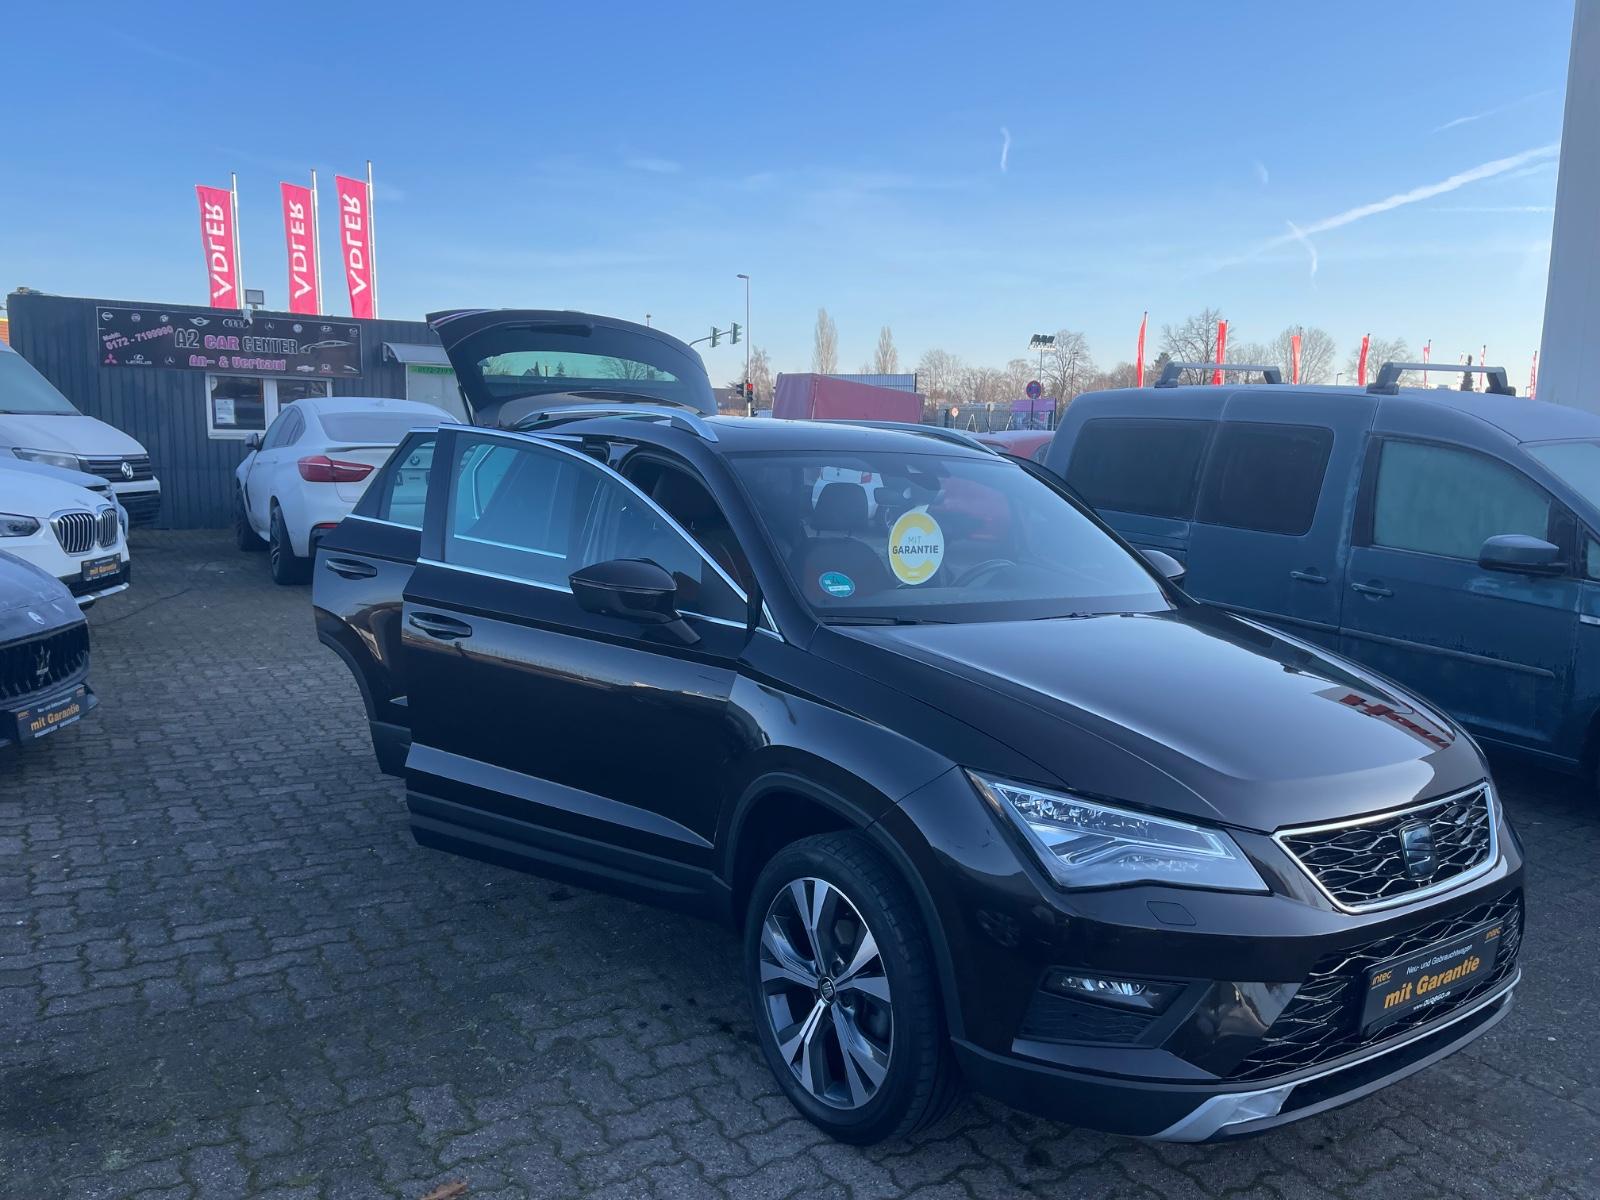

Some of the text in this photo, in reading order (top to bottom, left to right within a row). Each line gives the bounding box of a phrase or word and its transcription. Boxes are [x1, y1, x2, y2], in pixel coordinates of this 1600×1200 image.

[105, 337, 129, 350] 0172
[175, 328, 298, 354] A2 CAR CENTER
[218, 356, 229, 368] &
[908, 536, 922, 544] MIT
[892, 545, 939, 555] GARANTIE
[30, 716, 46, 731] mit
[47, 703, 80, 723] Garantie
[1420, 960, 1431, 970] und
[1383, 983, 1412, 1009] mit
[1416, 955, 1480, 995] Garantie
